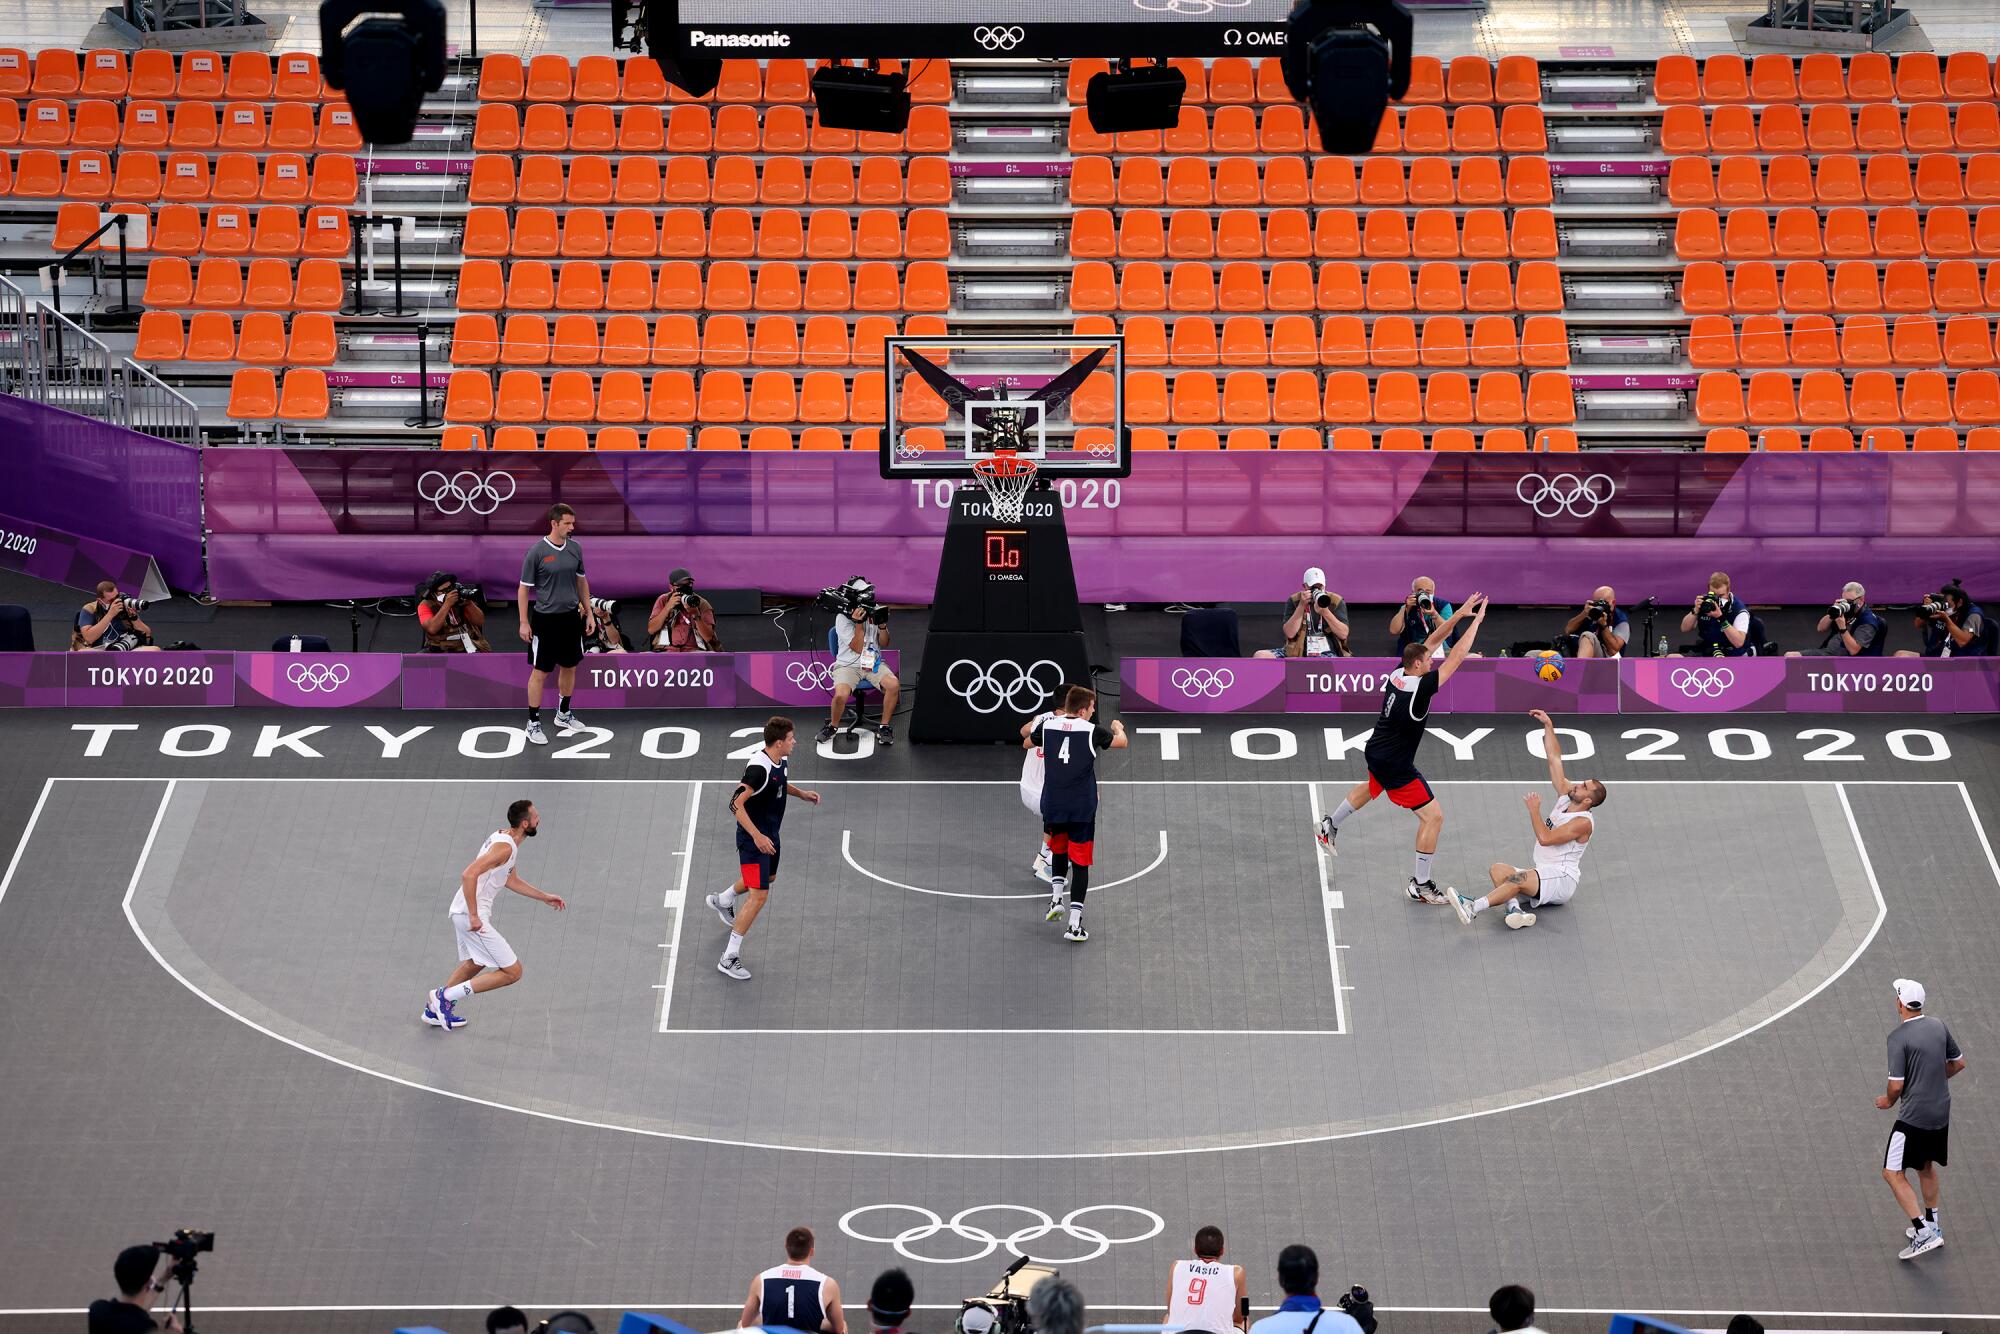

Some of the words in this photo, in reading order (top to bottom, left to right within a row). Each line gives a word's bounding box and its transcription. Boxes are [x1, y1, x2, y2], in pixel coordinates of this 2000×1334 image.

[690, 31, 791, 47] Panasonic
[1246, 31, 1289, 45] OME
[415, 161, 422, 170] G
[455, 162, 469, 170] 118
[953, 165, 967, 173] 118
[1006, 164, 1013, 173] G
[1600, 164, 1607, 173] G
[335, 375, 349, 383] 117
[390, 375, 397, 384] C
[433, 376, 446, 384] 118
[1006, 377, 1013, 386] C
[1624, 376, 1631, 386] C
[1060, 479, 1121, 509] 020
[4, 530, 37, 555] 2020
[987, 536, 1020, 568] 0.0
[88, 667, 157, 686] TOKYO
[163, 667, 213, 686] 2020
[590, 669, 659, 688] TOKYO
[664, 669, 714, 687] 2020
[1306, 674, 1375, 692] TOKYO
[1808, 674, 1877, 692] TOKYO
[1882, 674, 1933, 692] 2020
[1057, 736, 1071, 764] 4
[1187, 1277, 1207, 1305] 9
[785, 1284, 795, 1319] 1
